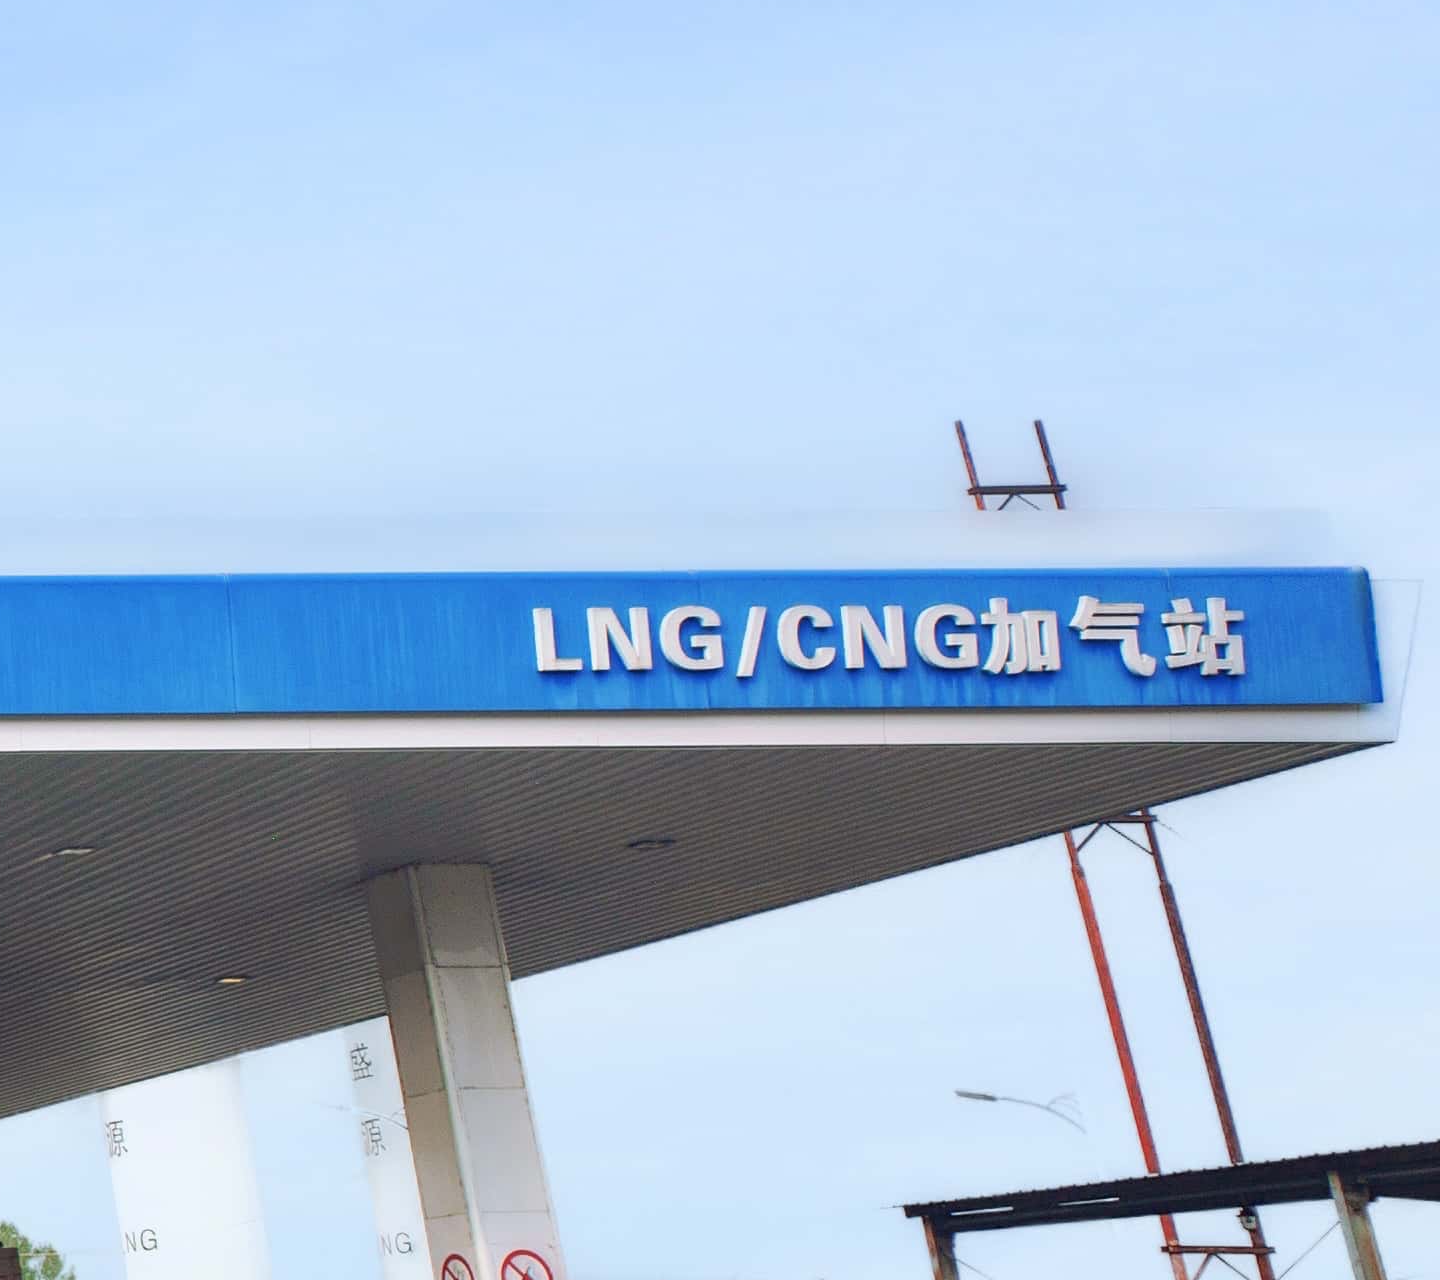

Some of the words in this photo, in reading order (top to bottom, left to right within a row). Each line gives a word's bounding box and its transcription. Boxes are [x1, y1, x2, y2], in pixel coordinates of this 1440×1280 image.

[532, 595, 1246, 677] LNG/CNG加气站
[124, 1228, 158, 1252] NG
